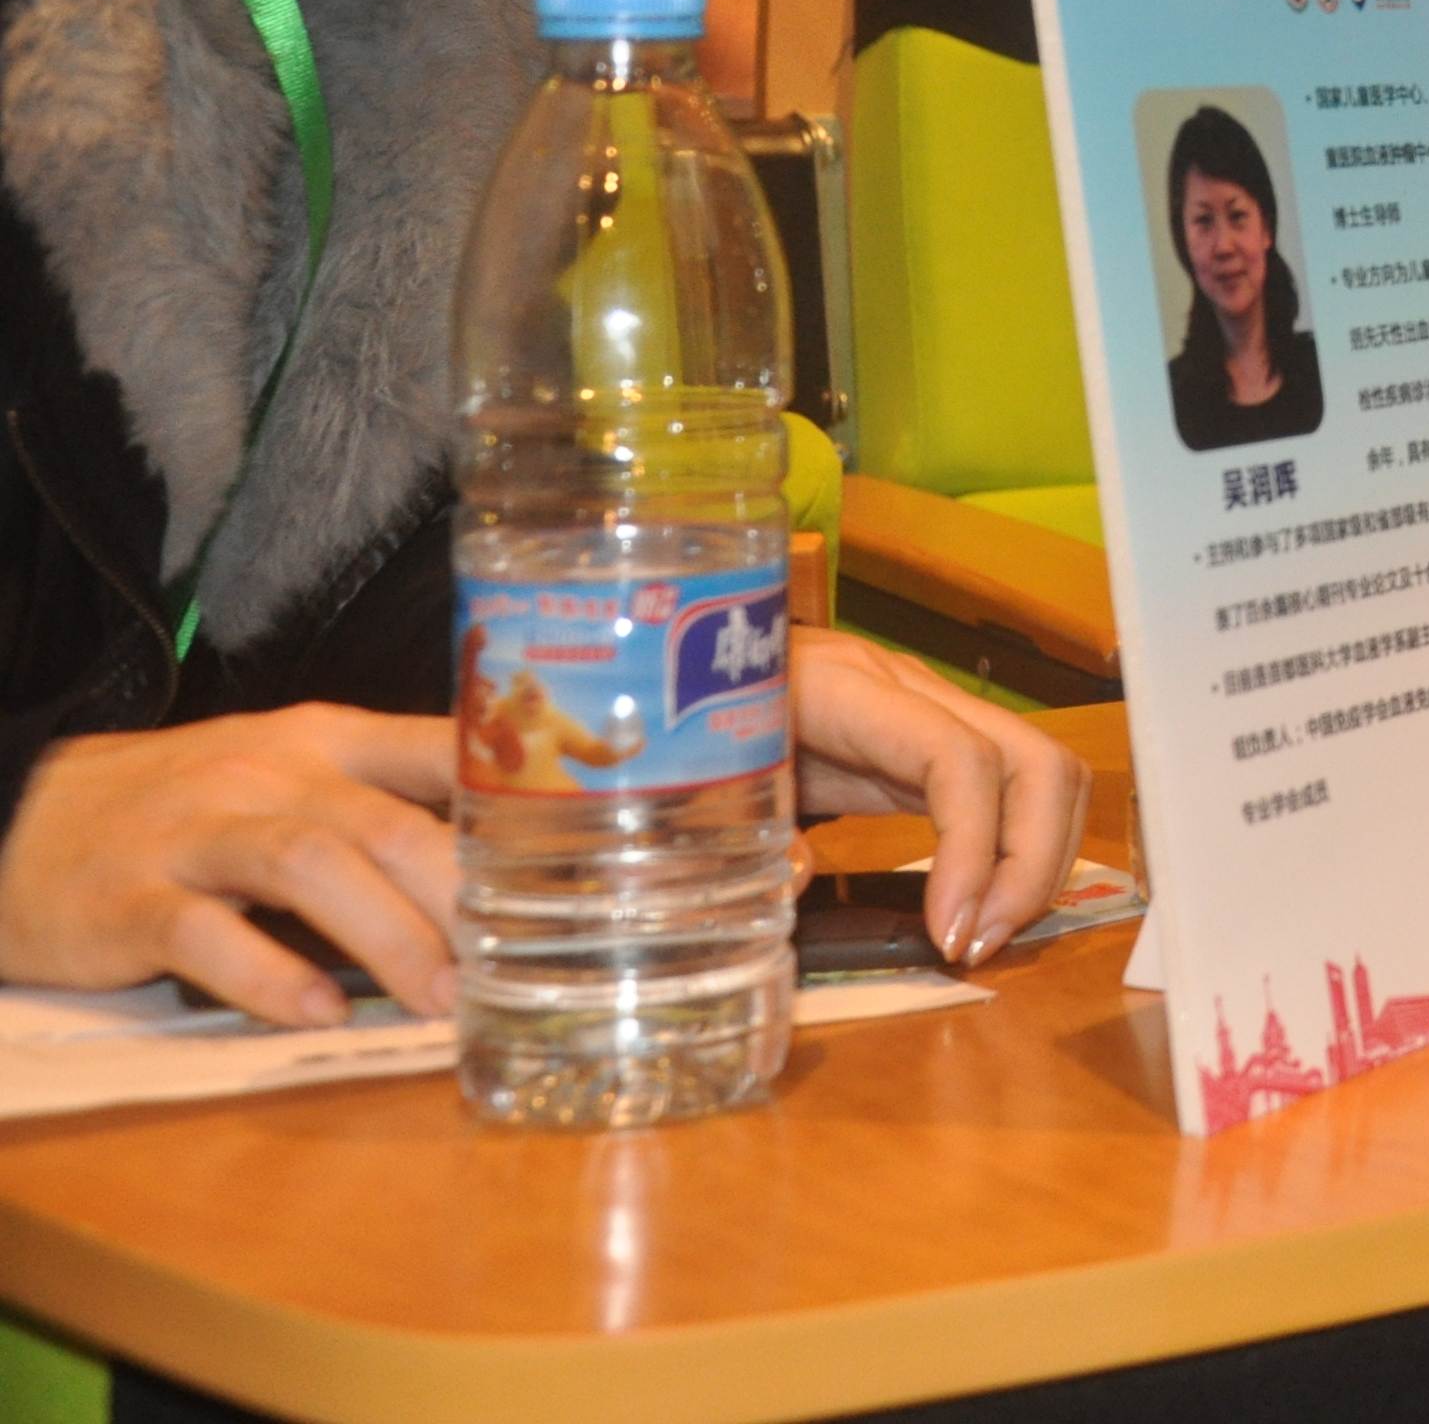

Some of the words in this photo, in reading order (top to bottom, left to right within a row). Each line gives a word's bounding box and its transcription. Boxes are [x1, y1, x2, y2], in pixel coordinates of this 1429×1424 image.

[1333, 202, 1401, 229] 博士生导师
